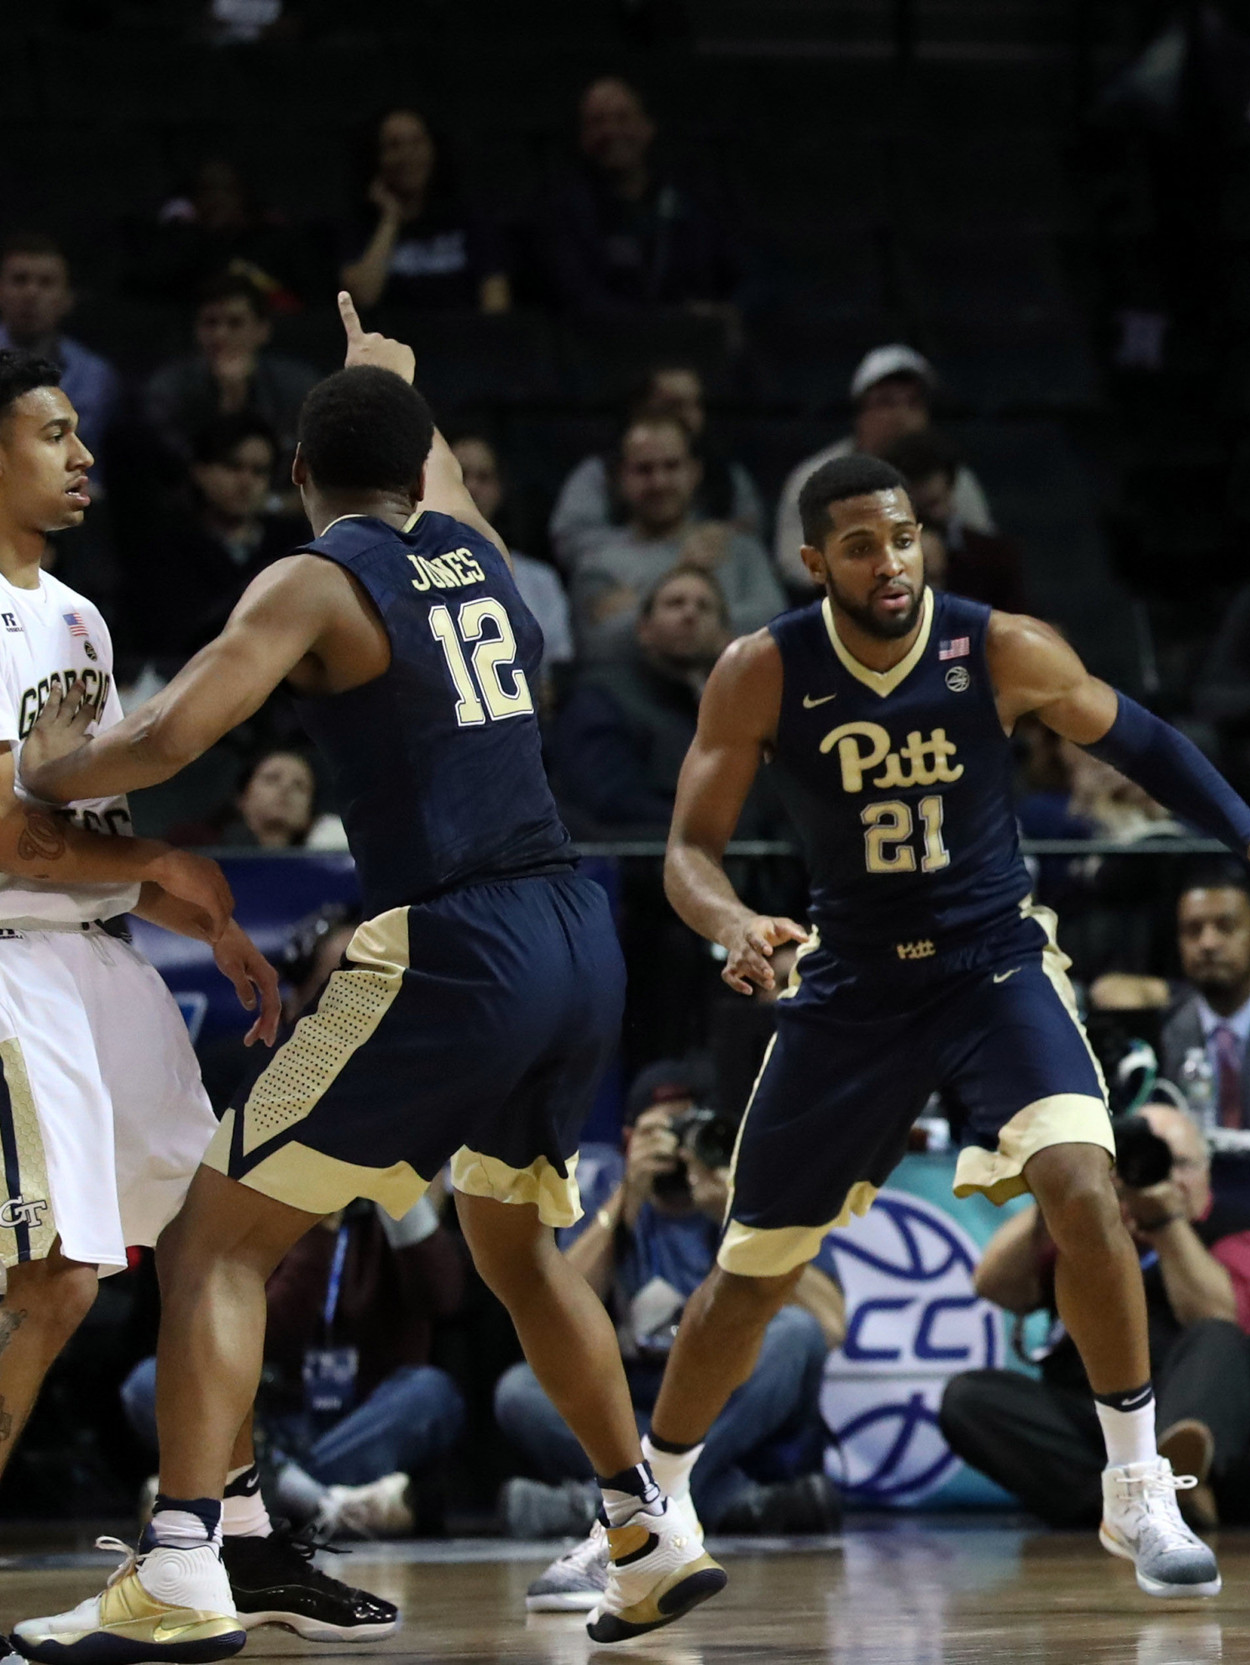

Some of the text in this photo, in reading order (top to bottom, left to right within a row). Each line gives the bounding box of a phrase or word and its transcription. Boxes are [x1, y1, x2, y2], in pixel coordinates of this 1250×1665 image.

[406, 547, 486, 591] JONES
[428, 597, 534, 726] 12
[819, 721, 964, 793] Pitt
[860, 795, 950, 873] 21
[845, 1297, 980, 1359] CC
